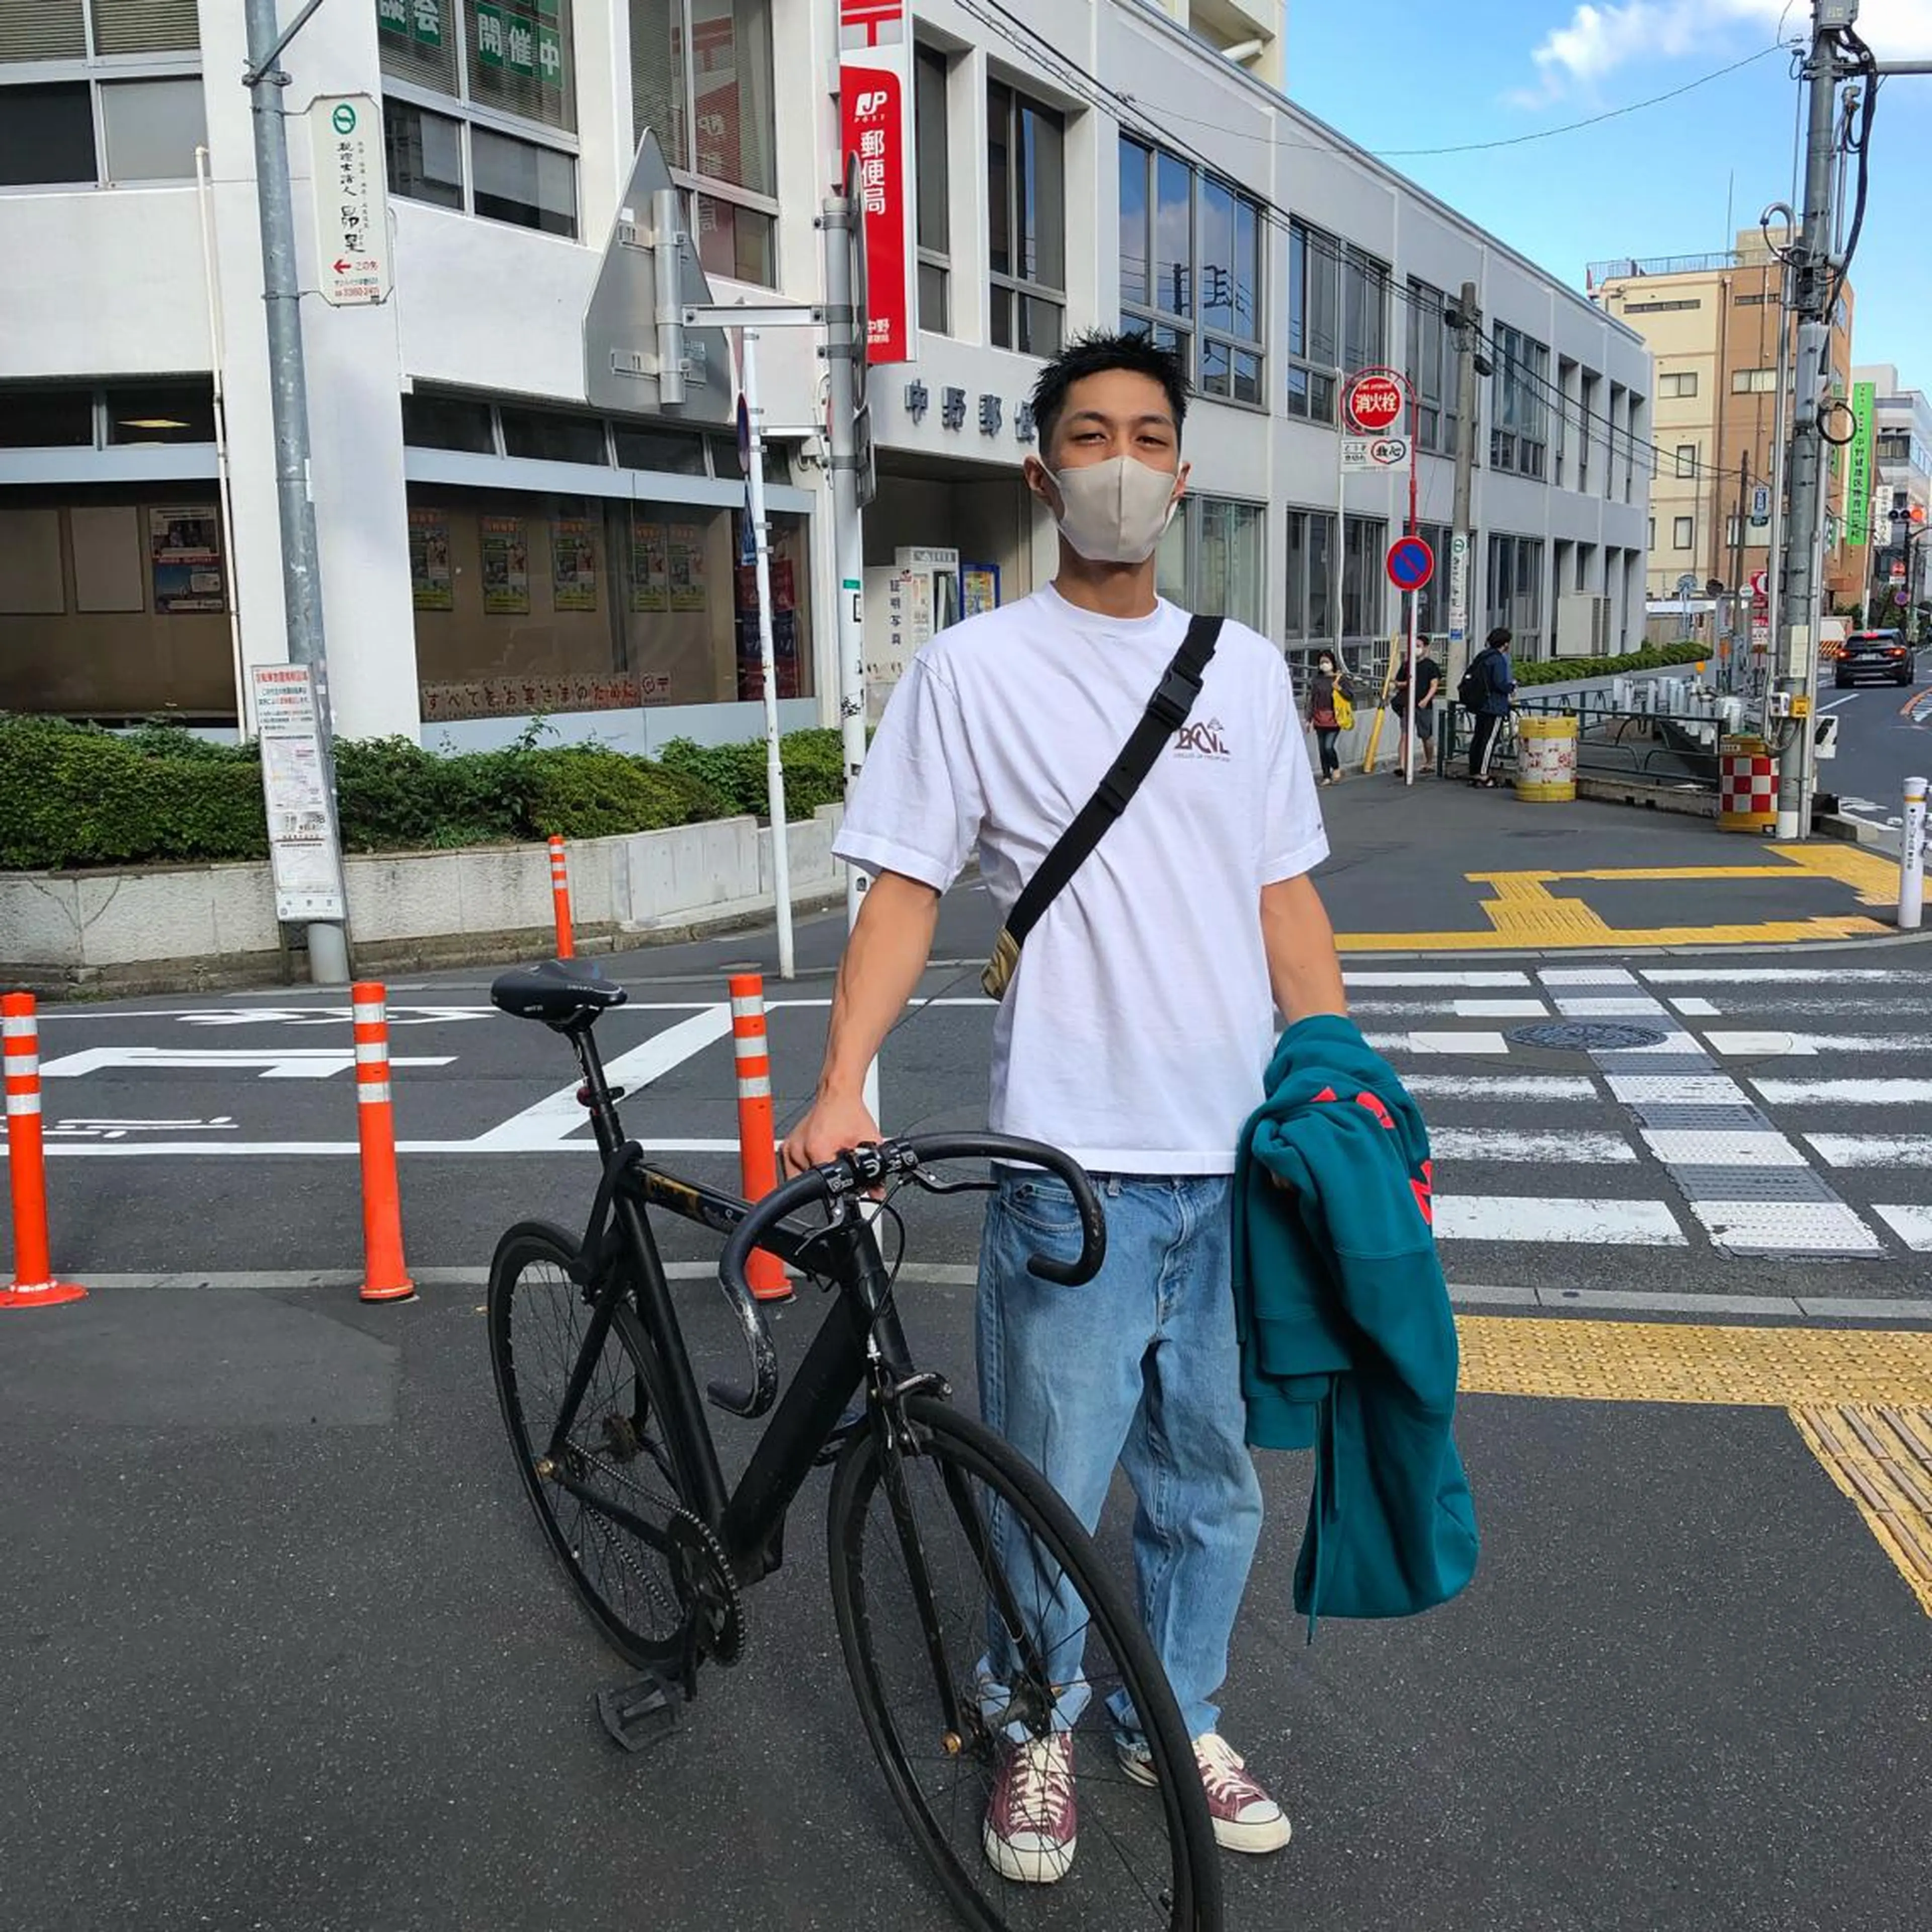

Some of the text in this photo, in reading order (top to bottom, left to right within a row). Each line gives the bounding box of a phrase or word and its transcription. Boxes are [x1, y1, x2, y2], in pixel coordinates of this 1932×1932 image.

[478, 13, 559, 74] 開催中
[856, 91, 888, 116] JP
[861, 130, 885, 215] 郵便局
[1355, 392, 1397, 414] 消火栓
[890, 580, 901, 645] 証明写真
